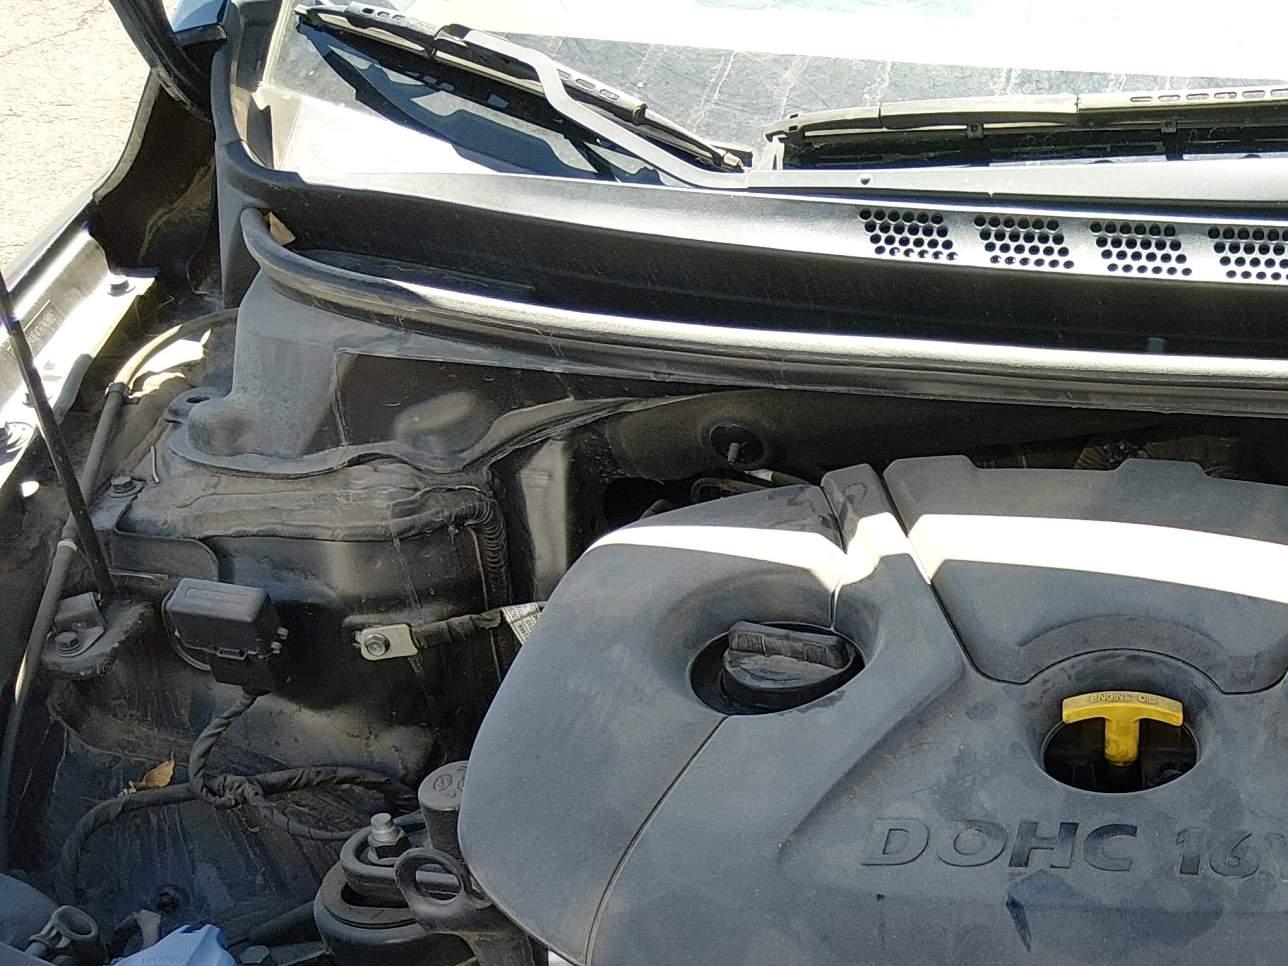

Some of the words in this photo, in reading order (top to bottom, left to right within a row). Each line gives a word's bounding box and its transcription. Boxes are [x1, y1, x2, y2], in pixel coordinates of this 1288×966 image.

[1090, 693, 1132, 703] ENGINE
[1138, 695, 1159, 704] OIL
[861, 817, 1137, 872] DOHC
